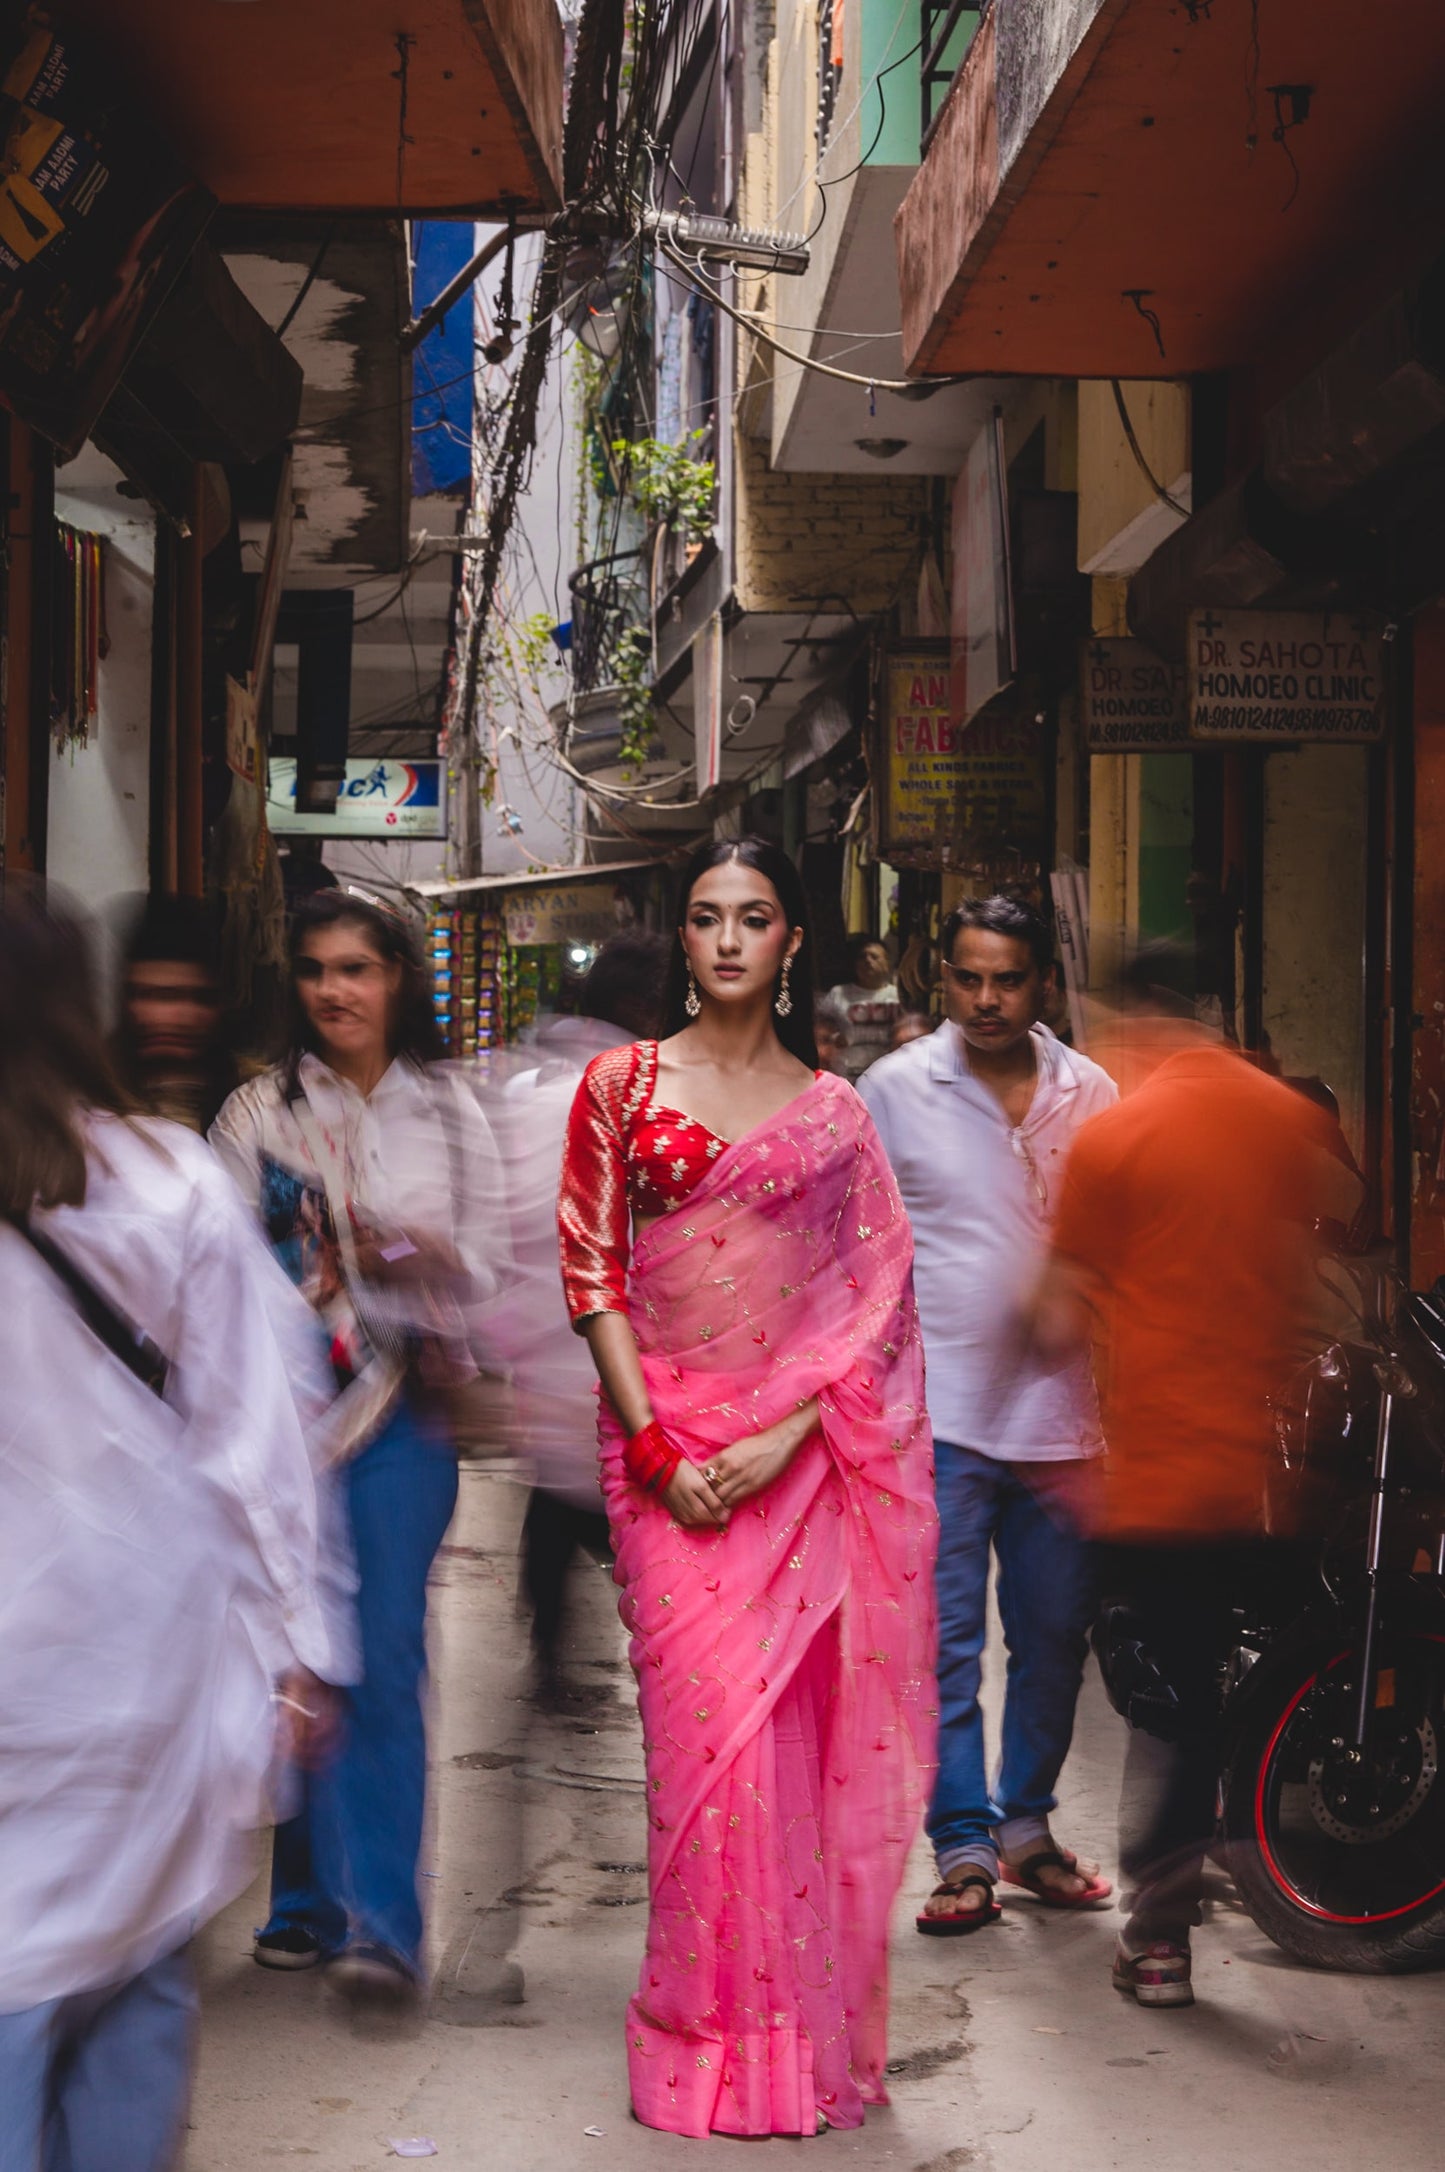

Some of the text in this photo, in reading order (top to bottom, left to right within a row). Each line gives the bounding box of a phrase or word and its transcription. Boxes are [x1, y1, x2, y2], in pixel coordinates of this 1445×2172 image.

[30, 43, 66, 106] AAM AADMI
[46, 61, 70, 99] PARTY
[46, 135, 76, 168] AADMI
[49, 154, 79, 191] PARTY
[1197, 640, 1367, 670] DR. SAHOTA
[1198, 673, 1377, 702] HOMOEO CLINIC
[1091, 697, 1173, 718] HOMOEO
[933, 761, 969, 773] KINDS
[899, 779, 942, 791] WHOLE
[508, 893, 580, 912] ARYAN
